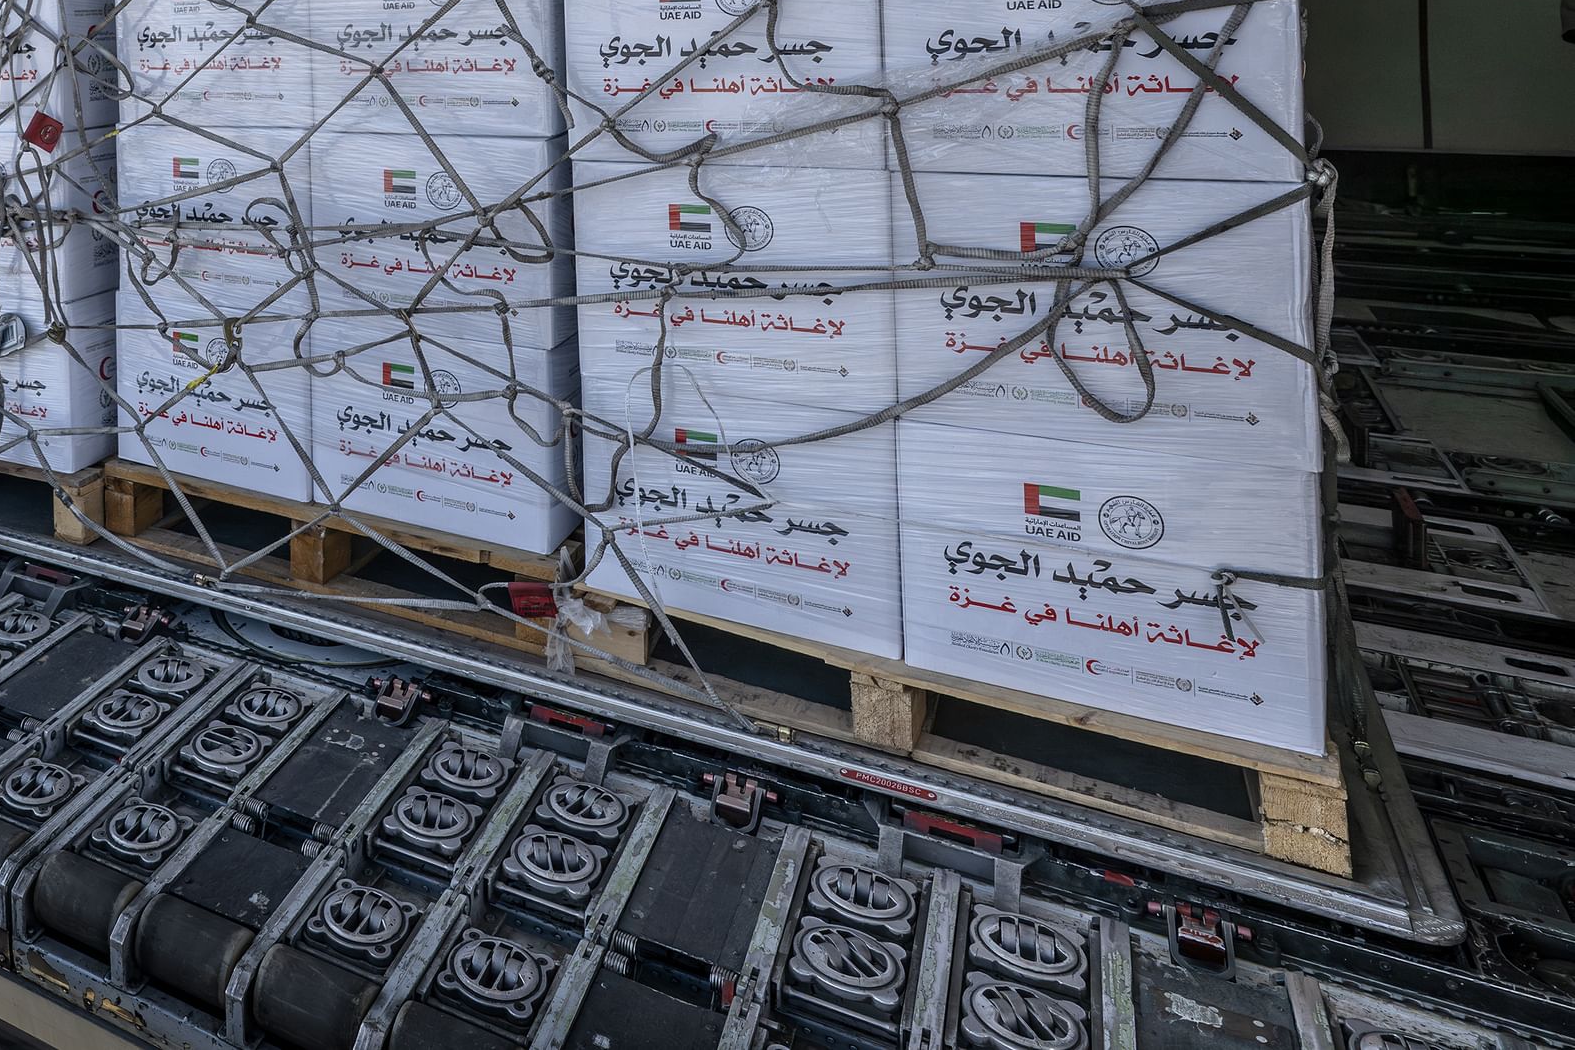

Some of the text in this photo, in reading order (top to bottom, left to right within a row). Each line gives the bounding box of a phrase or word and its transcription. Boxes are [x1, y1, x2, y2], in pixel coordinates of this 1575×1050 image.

[660, 12, 681, 20] UAE
[1007, 0, 1061, 11] UAE AID
[137, 21, 233, 51] حميد الجوي
[337, 22, 392, 51] الجوي
[926, 26, 1020, 65] الجوي
[599, 34, 833, 68] جسر الجوي
[140, 56, 281, 74] لإغاثة في غزة
[407, 57, 517, 76] لإغاثة أهلنا
[603, 75, 745, 100] أهلنا في غزة
[1006, 78, 1038, 100] في
[402, 201, 416, 209] AID
[669, 240, 711, 250] UAE AID
[341, 252, 516, 284] لإغاثة في غزة
[940, 286, 1036, 321] الجوي
[615, 301, 845, 338] لإغاثة أهلنا في غزة
[173, 358, 198, 370] UAE AID
[1020, 340, 1135, 366] أهلنا في
[10, 377, 46, 396] جسر
[136, 371, 179, 395] الجوي
[383, 393, 414, 405] UAE AID
[172, 411, 277, 443] لإغاثة أهلنا في
[337, 406, 391, 434] الجوي
[340, 440, 513, 487] لإغاثة أهلنا غزة
[675, 464, 697, 475] UAE
[776, 518, 849, 546] جسر
[1026, 525, 1081, 542] UAE AID
[675, 531, 850, 579] لإغاثة أهلنا في
[943, 541, 1040, 580] الجوي
[1052, 559, 1156, 601] حميد
[949, 586, 1259, 659] لإغاثة أهلنا في غزة
[856, 772, 921, 795] PMC20026BSC
